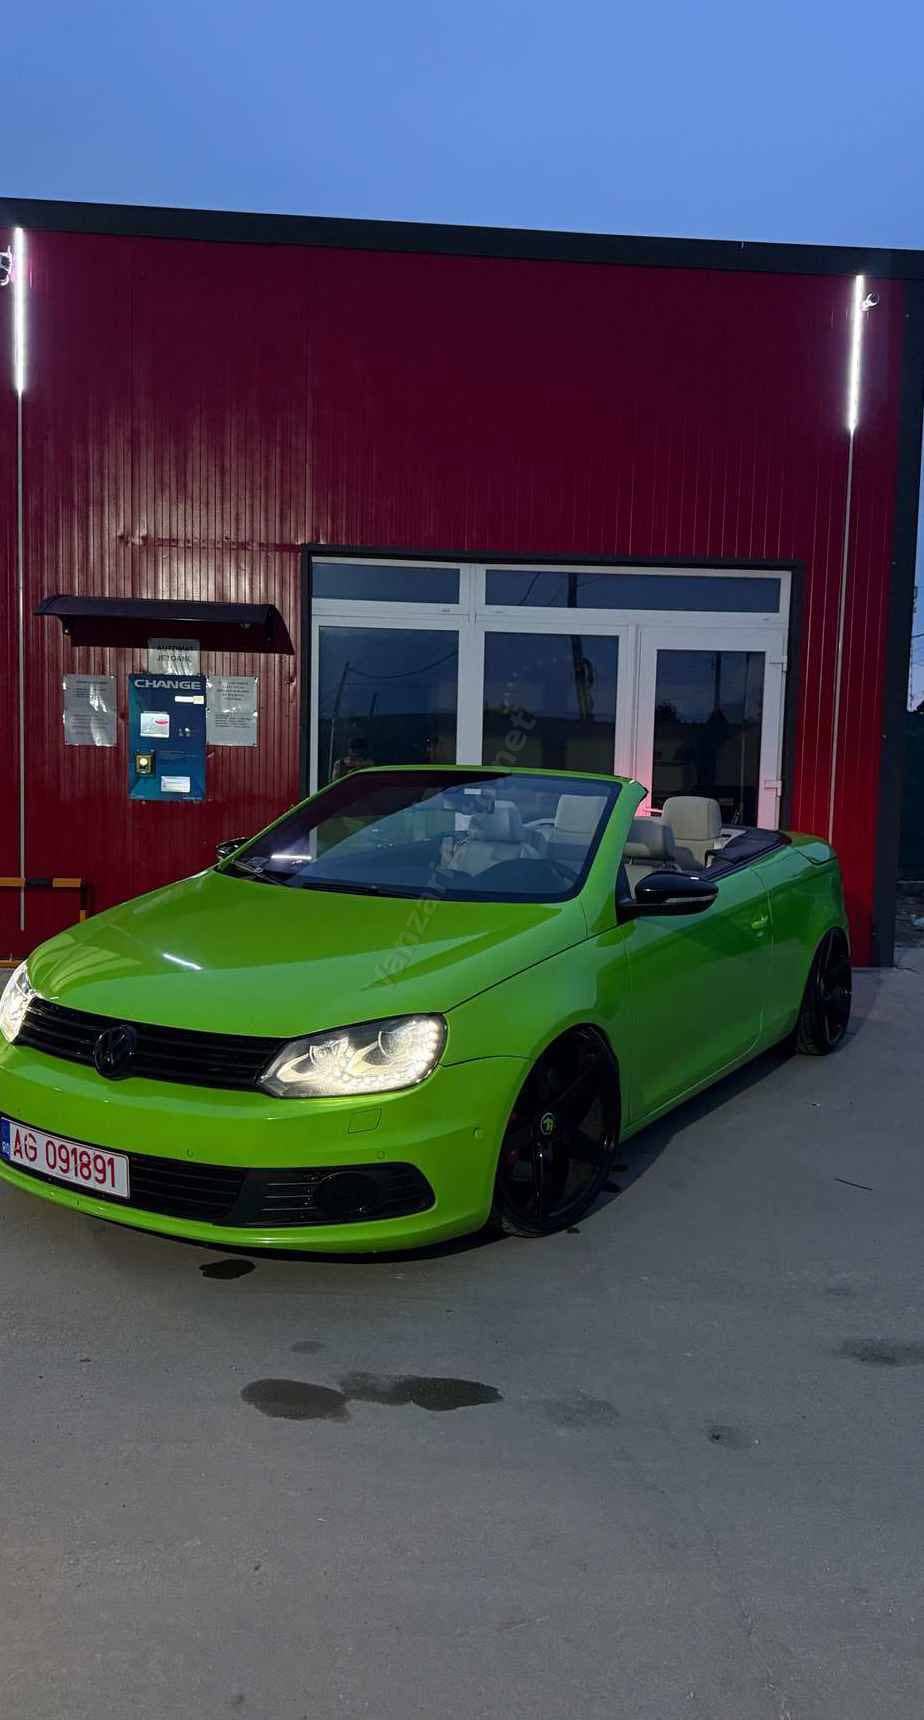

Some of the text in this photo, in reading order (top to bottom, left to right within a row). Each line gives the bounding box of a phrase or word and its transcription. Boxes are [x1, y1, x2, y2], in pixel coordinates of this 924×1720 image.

[134, 678, 202, 690] CHANGE
[13, 1128, 116, 1187] AG 091891
